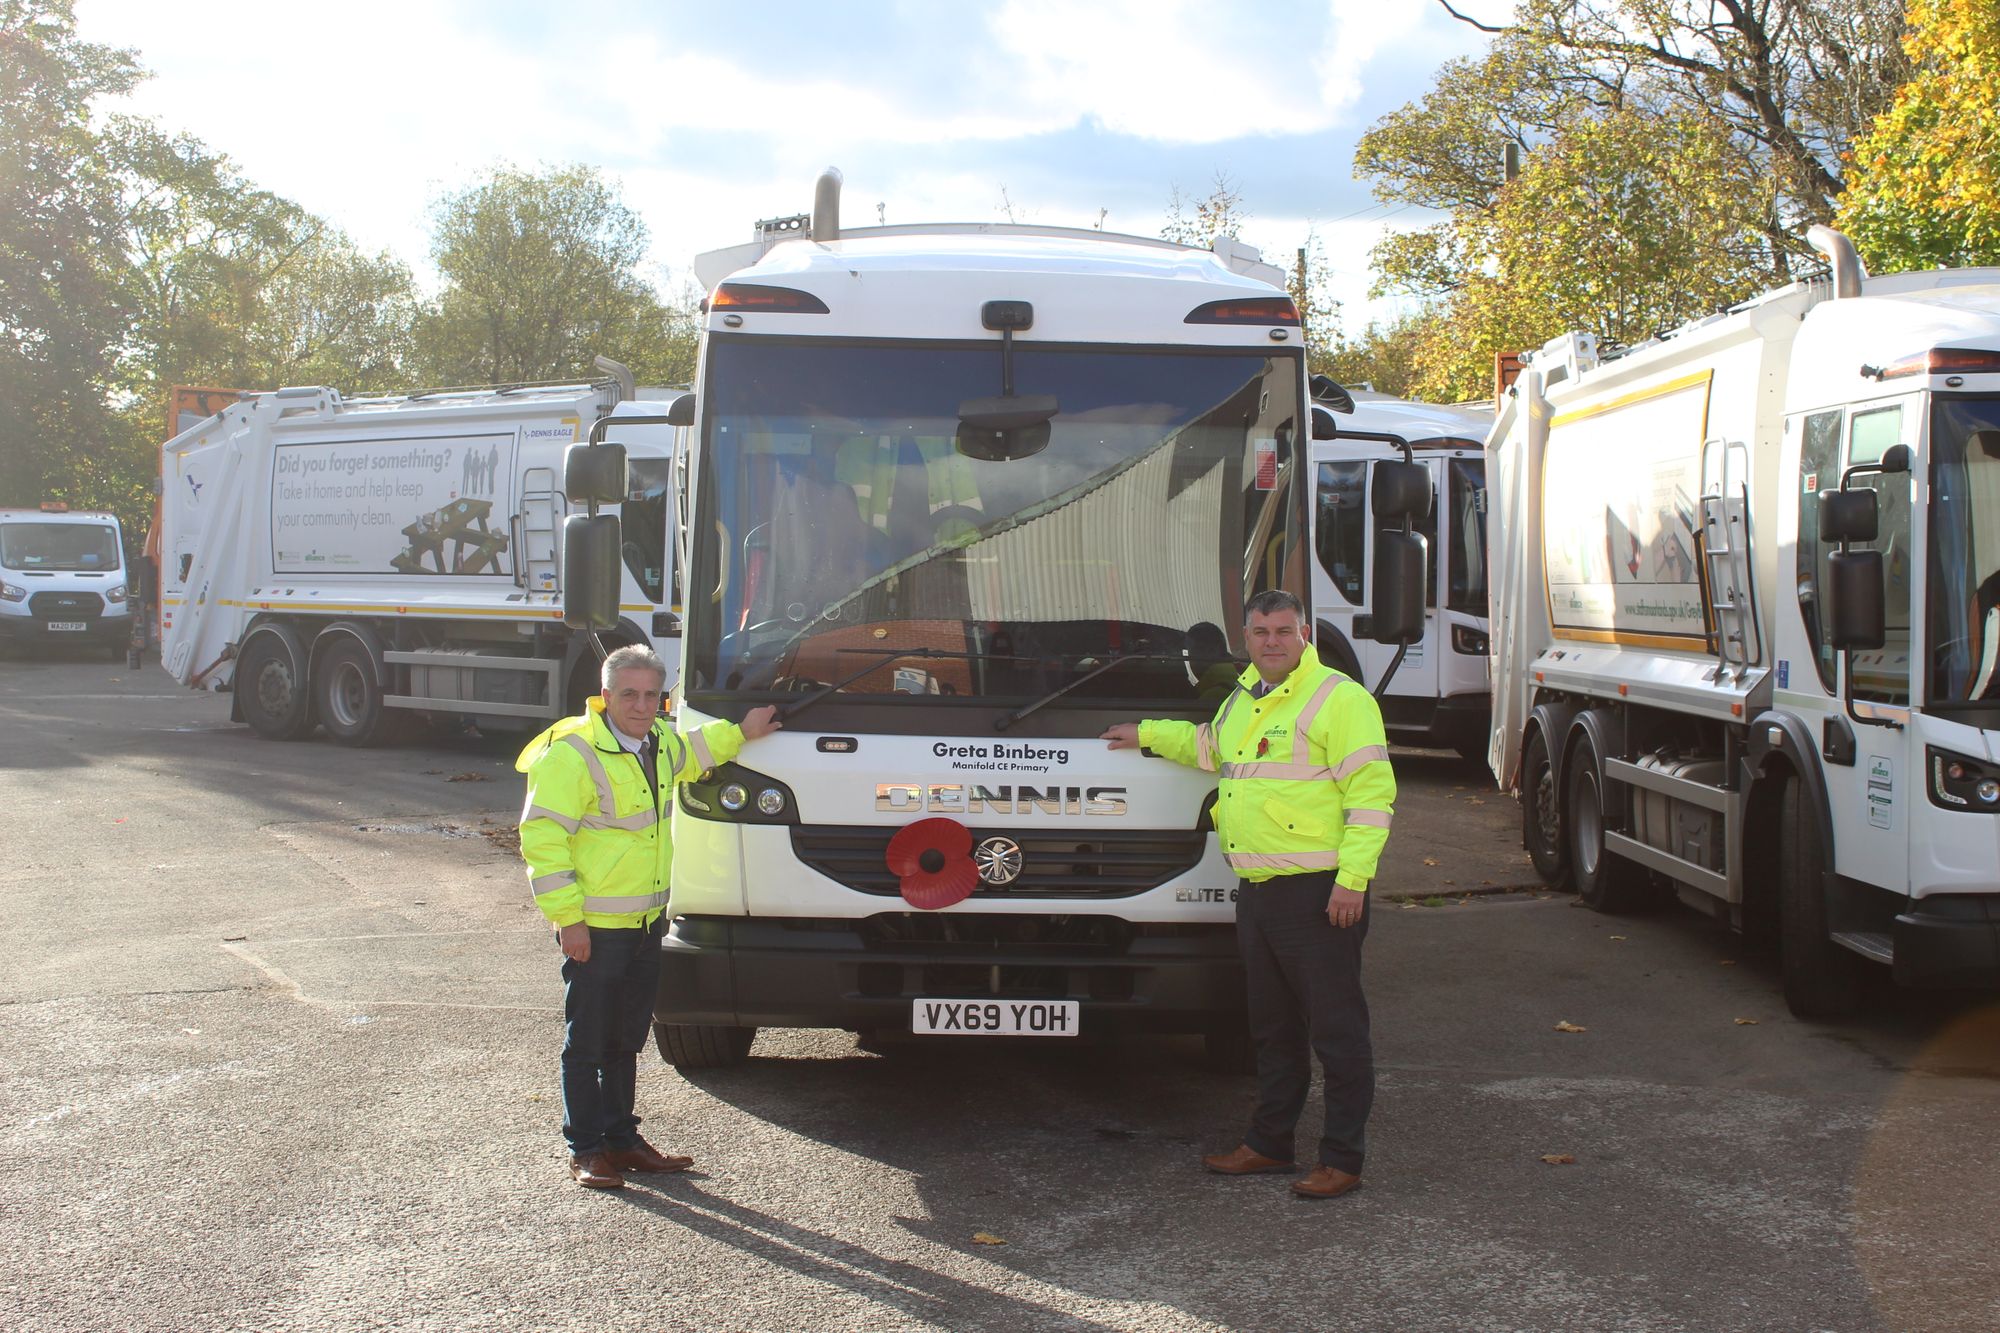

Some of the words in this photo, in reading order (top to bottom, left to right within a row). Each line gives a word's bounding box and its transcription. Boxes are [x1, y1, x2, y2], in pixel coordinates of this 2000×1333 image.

[278, 454, 300, 473] Did
[302, 458, 326, 477] you
[329, 452, 369, 476] forget
[371, 448, 452, 473] something?
[278, 481, 303, 500] Take
[305, 480, 313, 498] it
[314, 478, 343, 498] home
[345, 477, 366, 498] and
[369, 477, 393, 501] help
[396, 476, 423, 500] keep
[277, 513, 300, 532] your
[302, 508, 360, 531] community
[361, 505, 395, 526] clean.
[932, 742, 988, 758] Greta
[993, 744, 1069, 764] Binberg
[952, 761, 995, 770] Manifold
[997, 762, 1009, 771] CE
[1011, 763, 1049, 774] Primary
[875, 783, 1127, 815] DENNIS
[1175, 888, 1225, 902] ELITE
[1229, 888, 1239, 902] 6
[925, 1003, 1001, 1030] VX69
[1010, 1004, 1067, 1031] YOH
